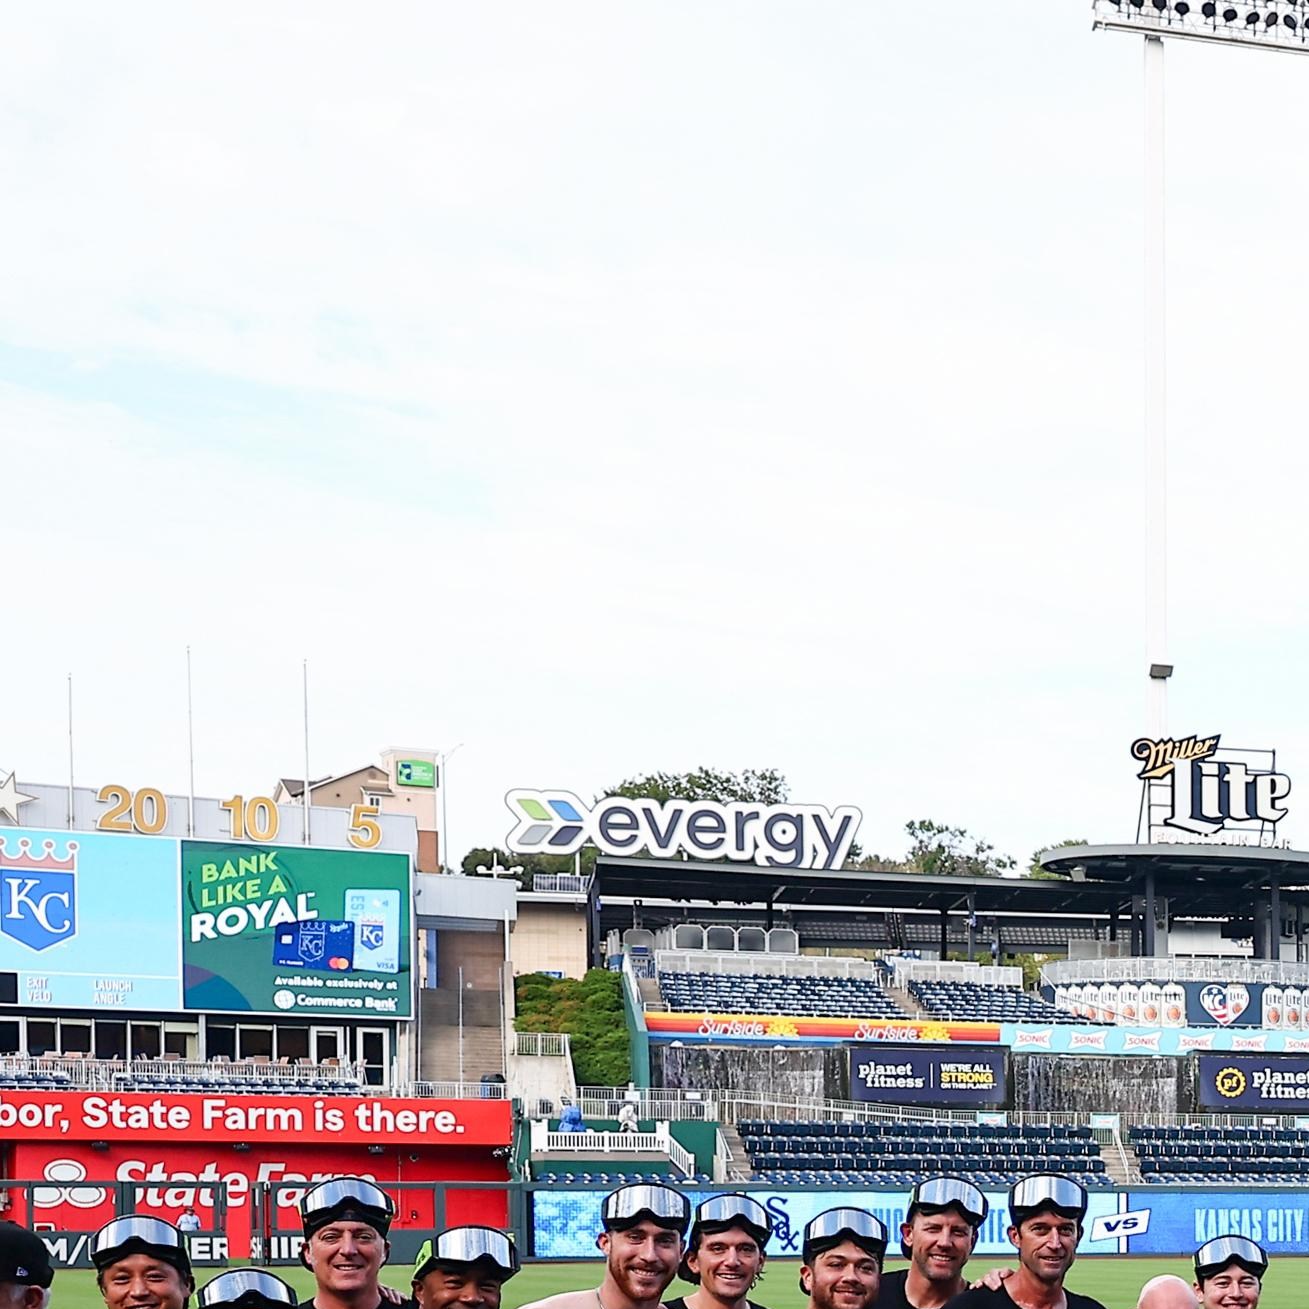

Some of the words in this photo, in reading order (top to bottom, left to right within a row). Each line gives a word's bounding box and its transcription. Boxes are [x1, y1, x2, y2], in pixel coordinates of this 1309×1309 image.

[1133, 737, 1217, 772] Miller
[97, 784, 168, 834] 20
[1164, 757, 1291, 834] Lite
[220, 794, 280, 842] 10
[347, 803, 383, 850] 5
[600, 804, 853, 869] evergy
[202, 852, 279, 884] BANK
[4, 877, 70, 935] KC
[202, 879, 261, 907] LIKE
[268, 874, 287, 894] A
[191, 893, 318, 942] ROYAL
[274, 976, 323, 987] Available
[326, 976, 383, 990] exclusively
[386, 981, 398, 990] at
[296, 995, 362, 1008] Commerce
[365, 997, 394, 1009] Bank
[698, 1018, 765, 1037] Surfside
[853, 1023, 917, 1041] Surfside
[1073, 1036, 1102, 1045] SONIC
[940, 1073, 993, 1082] STRONG
[82, 1097, 191, 1130] State
[203, 1099, 303, 1131] Farm
[314, 1101, 344, 1132] is
[355, 1102, 465, 1134] there.
